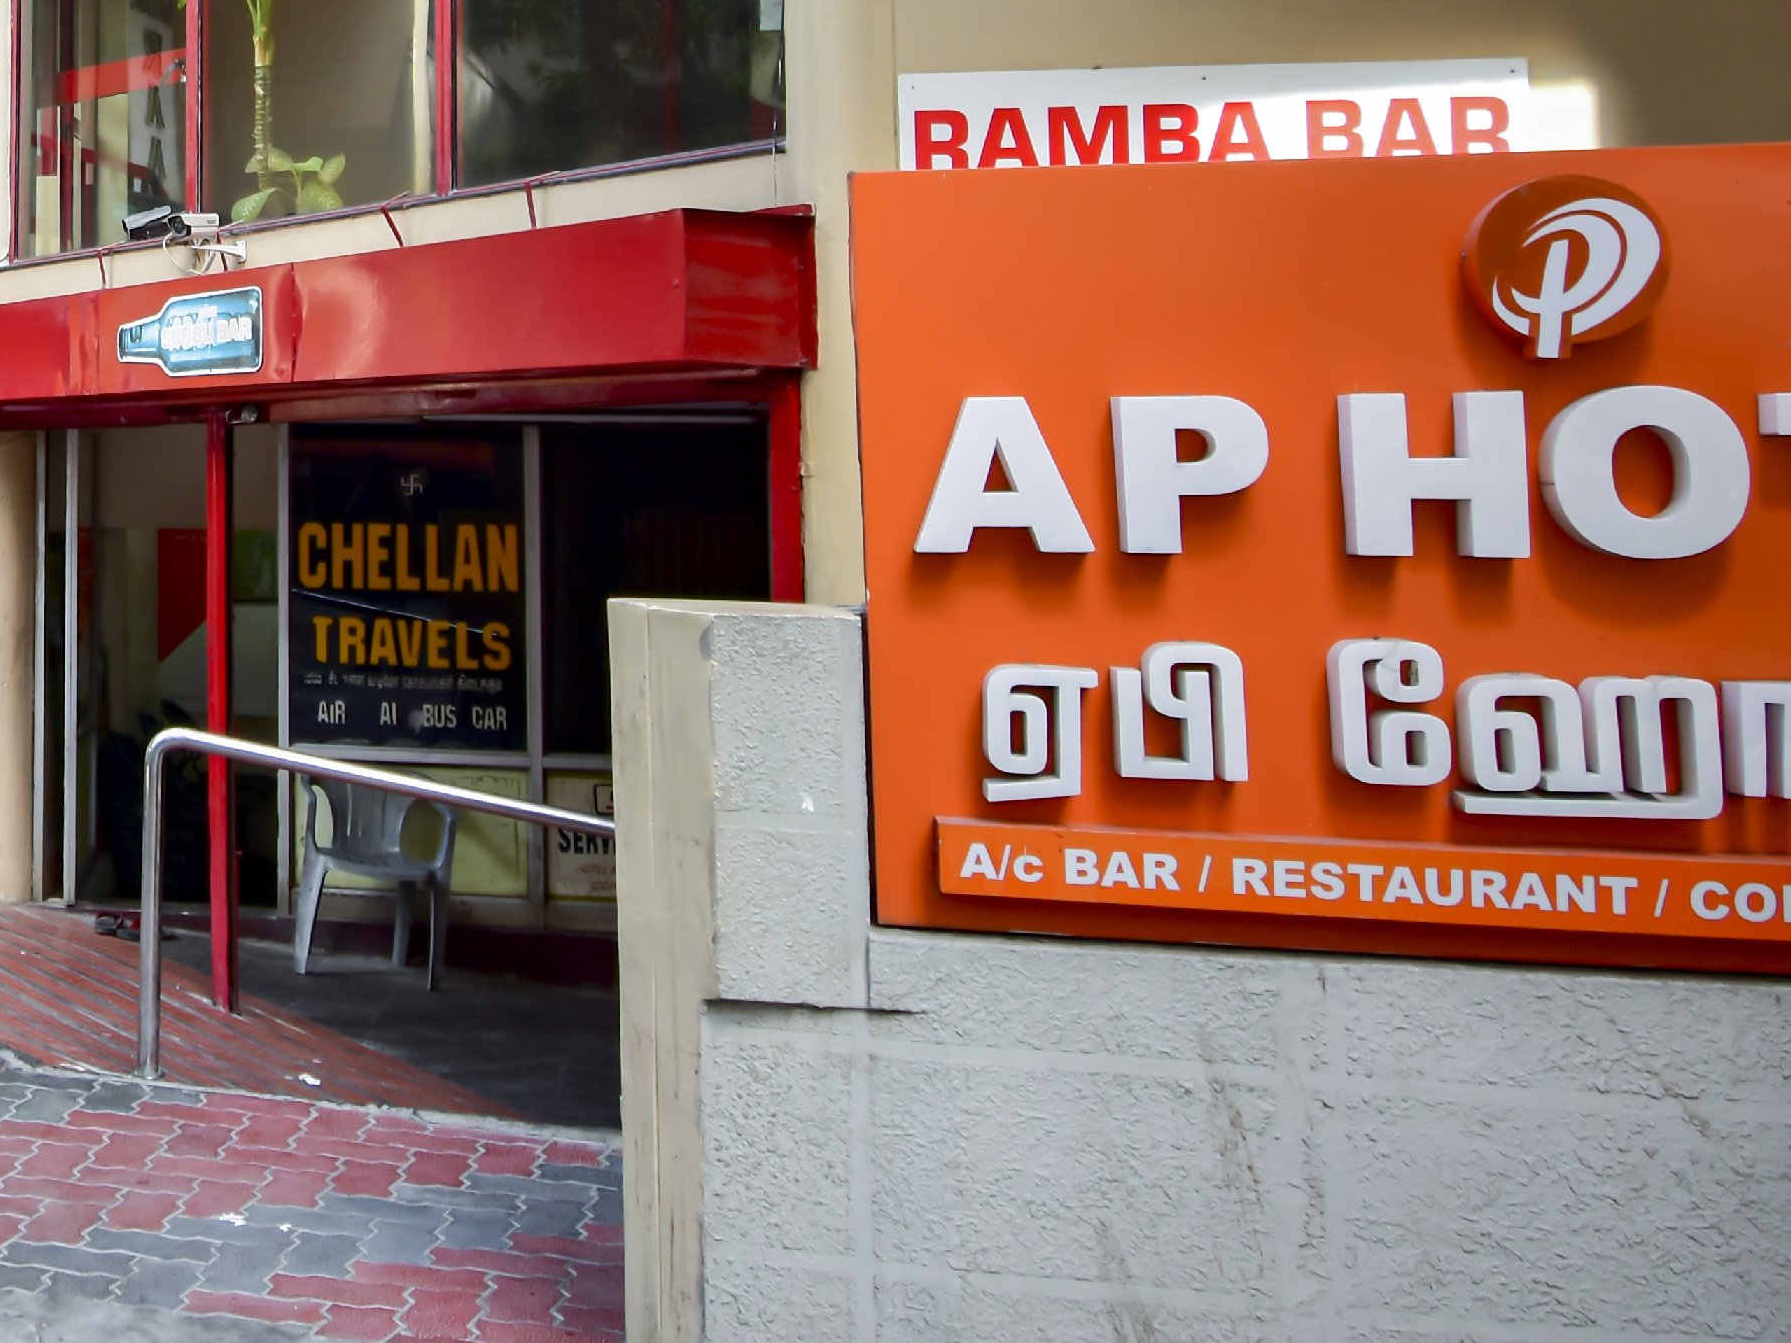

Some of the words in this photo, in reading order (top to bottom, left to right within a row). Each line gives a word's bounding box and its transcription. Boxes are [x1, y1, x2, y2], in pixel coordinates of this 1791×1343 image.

[913, 102, 1272, 171] RAMBA
[1305, 96, 1510, 160] BAR
[216, 317, 253, 342] BAR
[913, 394, 1269, 555] AP
[1337, 384, 1790, 559] HO
[297, 521, 519, 593] CHELLAN
[313, 614, 511, 671] TRAVELS
[422, 703, 458, 729] BUS
[472, 706, 507, 732] CAR
[1064, 847, 1181, 891] BAR
[1231, 856, 1638, 917] RESTAURANT
[1689, 880, 1790, 924] CO
